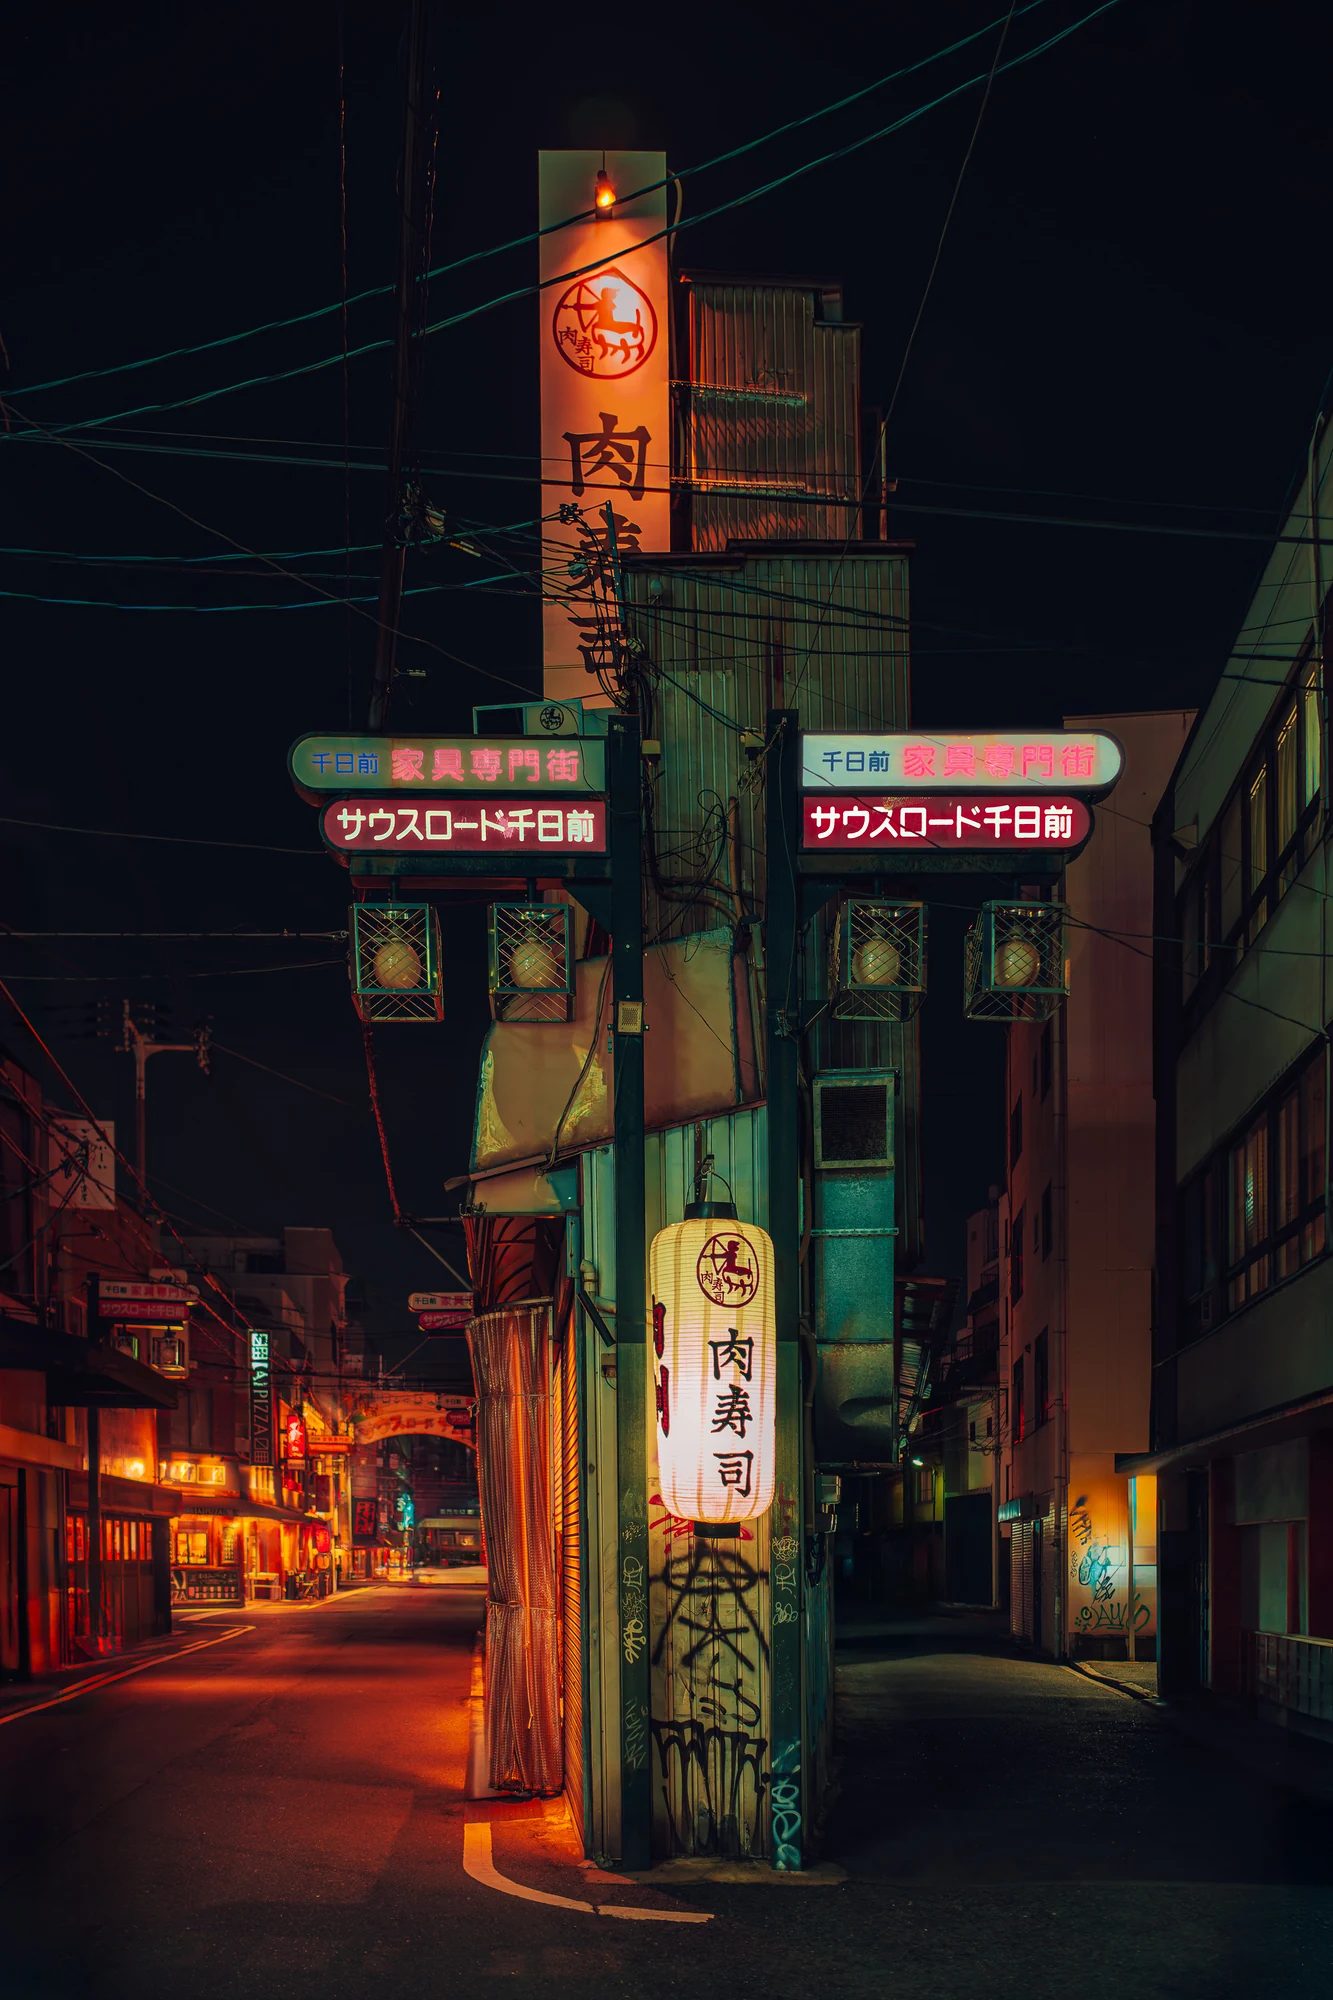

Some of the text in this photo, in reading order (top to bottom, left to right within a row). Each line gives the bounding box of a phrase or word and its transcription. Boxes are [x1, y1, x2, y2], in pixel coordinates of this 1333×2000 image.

[557, 326, 596, 372] 肉寿司
[311, 748, 579, 782] 千日前 家具専門街
[822, 744, 1095, 777] 千日前 家具専門街
[337, 808, 595, 842] サウスロード千日前
[810, 805, 1074, 839] サウスロード千日前
[701, 1271, 726, 1303] 肉寿司
[253, 1389, 269, 1435] PIZZA
[707, 1327, 755, 1498] 肉寿司
